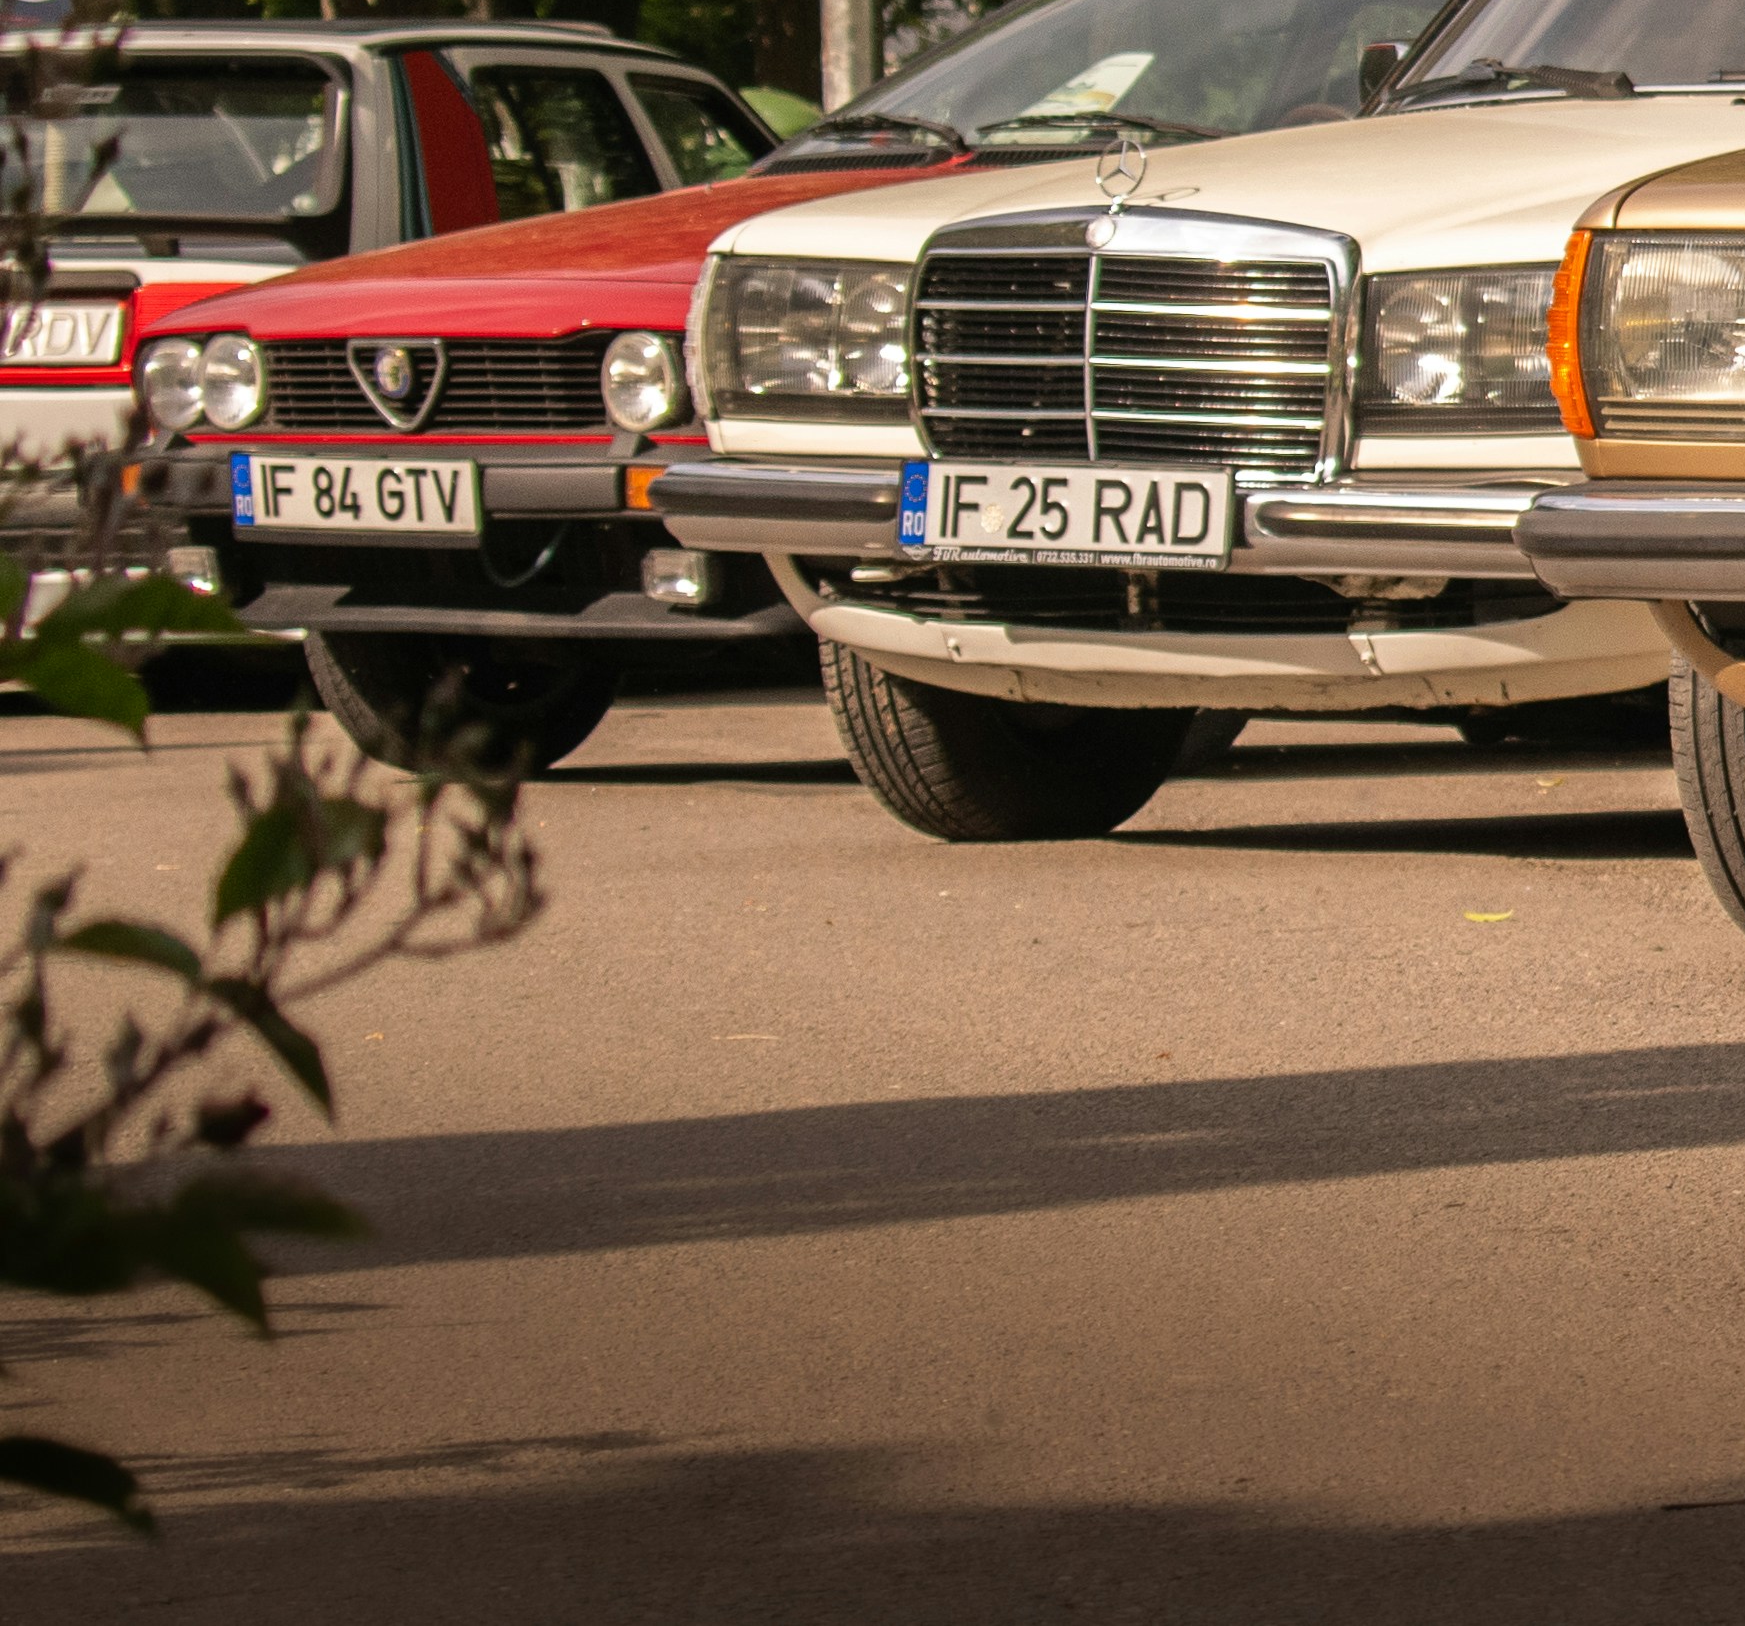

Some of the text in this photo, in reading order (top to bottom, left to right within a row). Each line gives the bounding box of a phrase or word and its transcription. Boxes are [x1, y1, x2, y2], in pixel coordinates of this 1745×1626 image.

[236, 494, 254, 519] RO
[260, 464, 461, 524] IF 84 GTV
[902, 510, 925, 537] RO
[939, 475, 1211, 546] IF 25 RAD
[1100, 552, 1217, 569] www.fbrautomotive.ro
